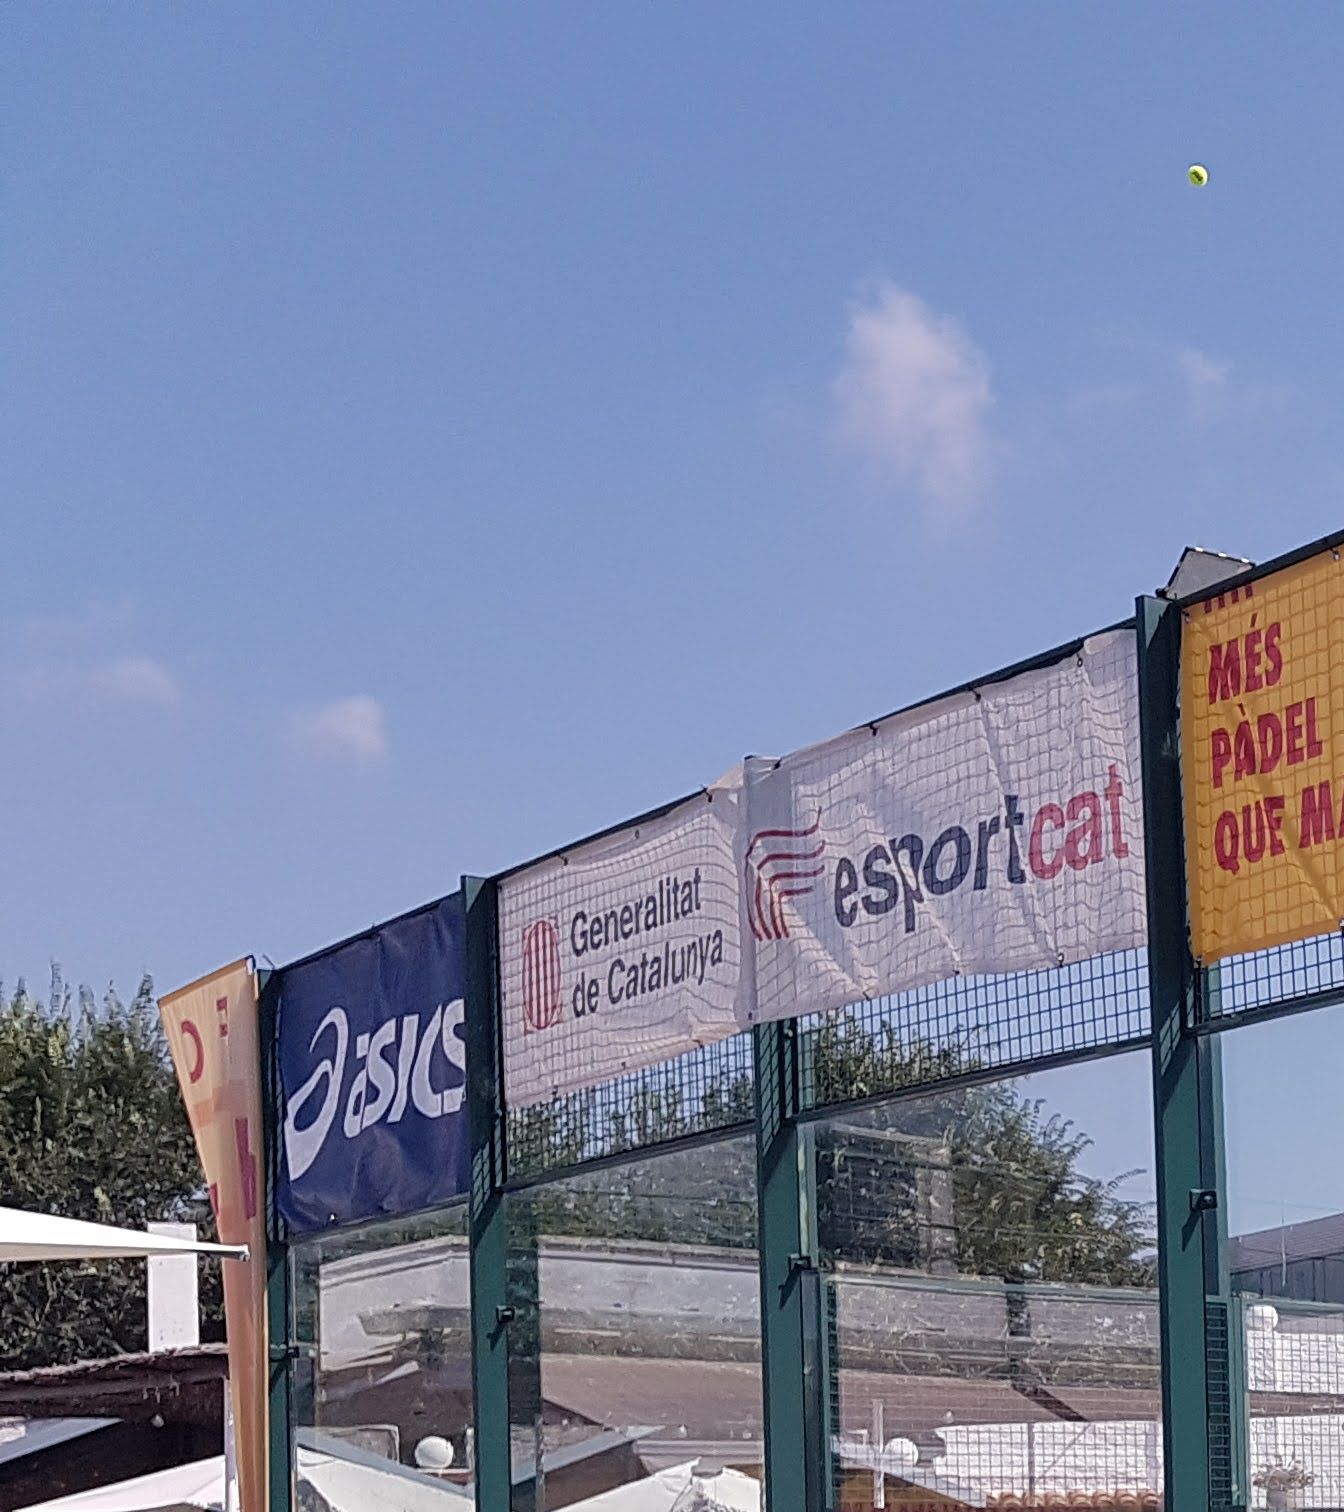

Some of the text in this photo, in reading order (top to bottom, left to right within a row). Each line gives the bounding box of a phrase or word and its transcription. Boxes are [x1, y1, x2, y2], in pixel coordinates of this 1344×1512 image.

[1207, 614, 1283, 706] MÉS
[1211, 698, 1322, 789] PÀDEL
[832, 764, 1129, 934] esportcat
[1214, 799, 1286, 876] QUE
[569, 868, 702, 957] Generalitat
[572, 925, 724, 1020] de Catalunya
